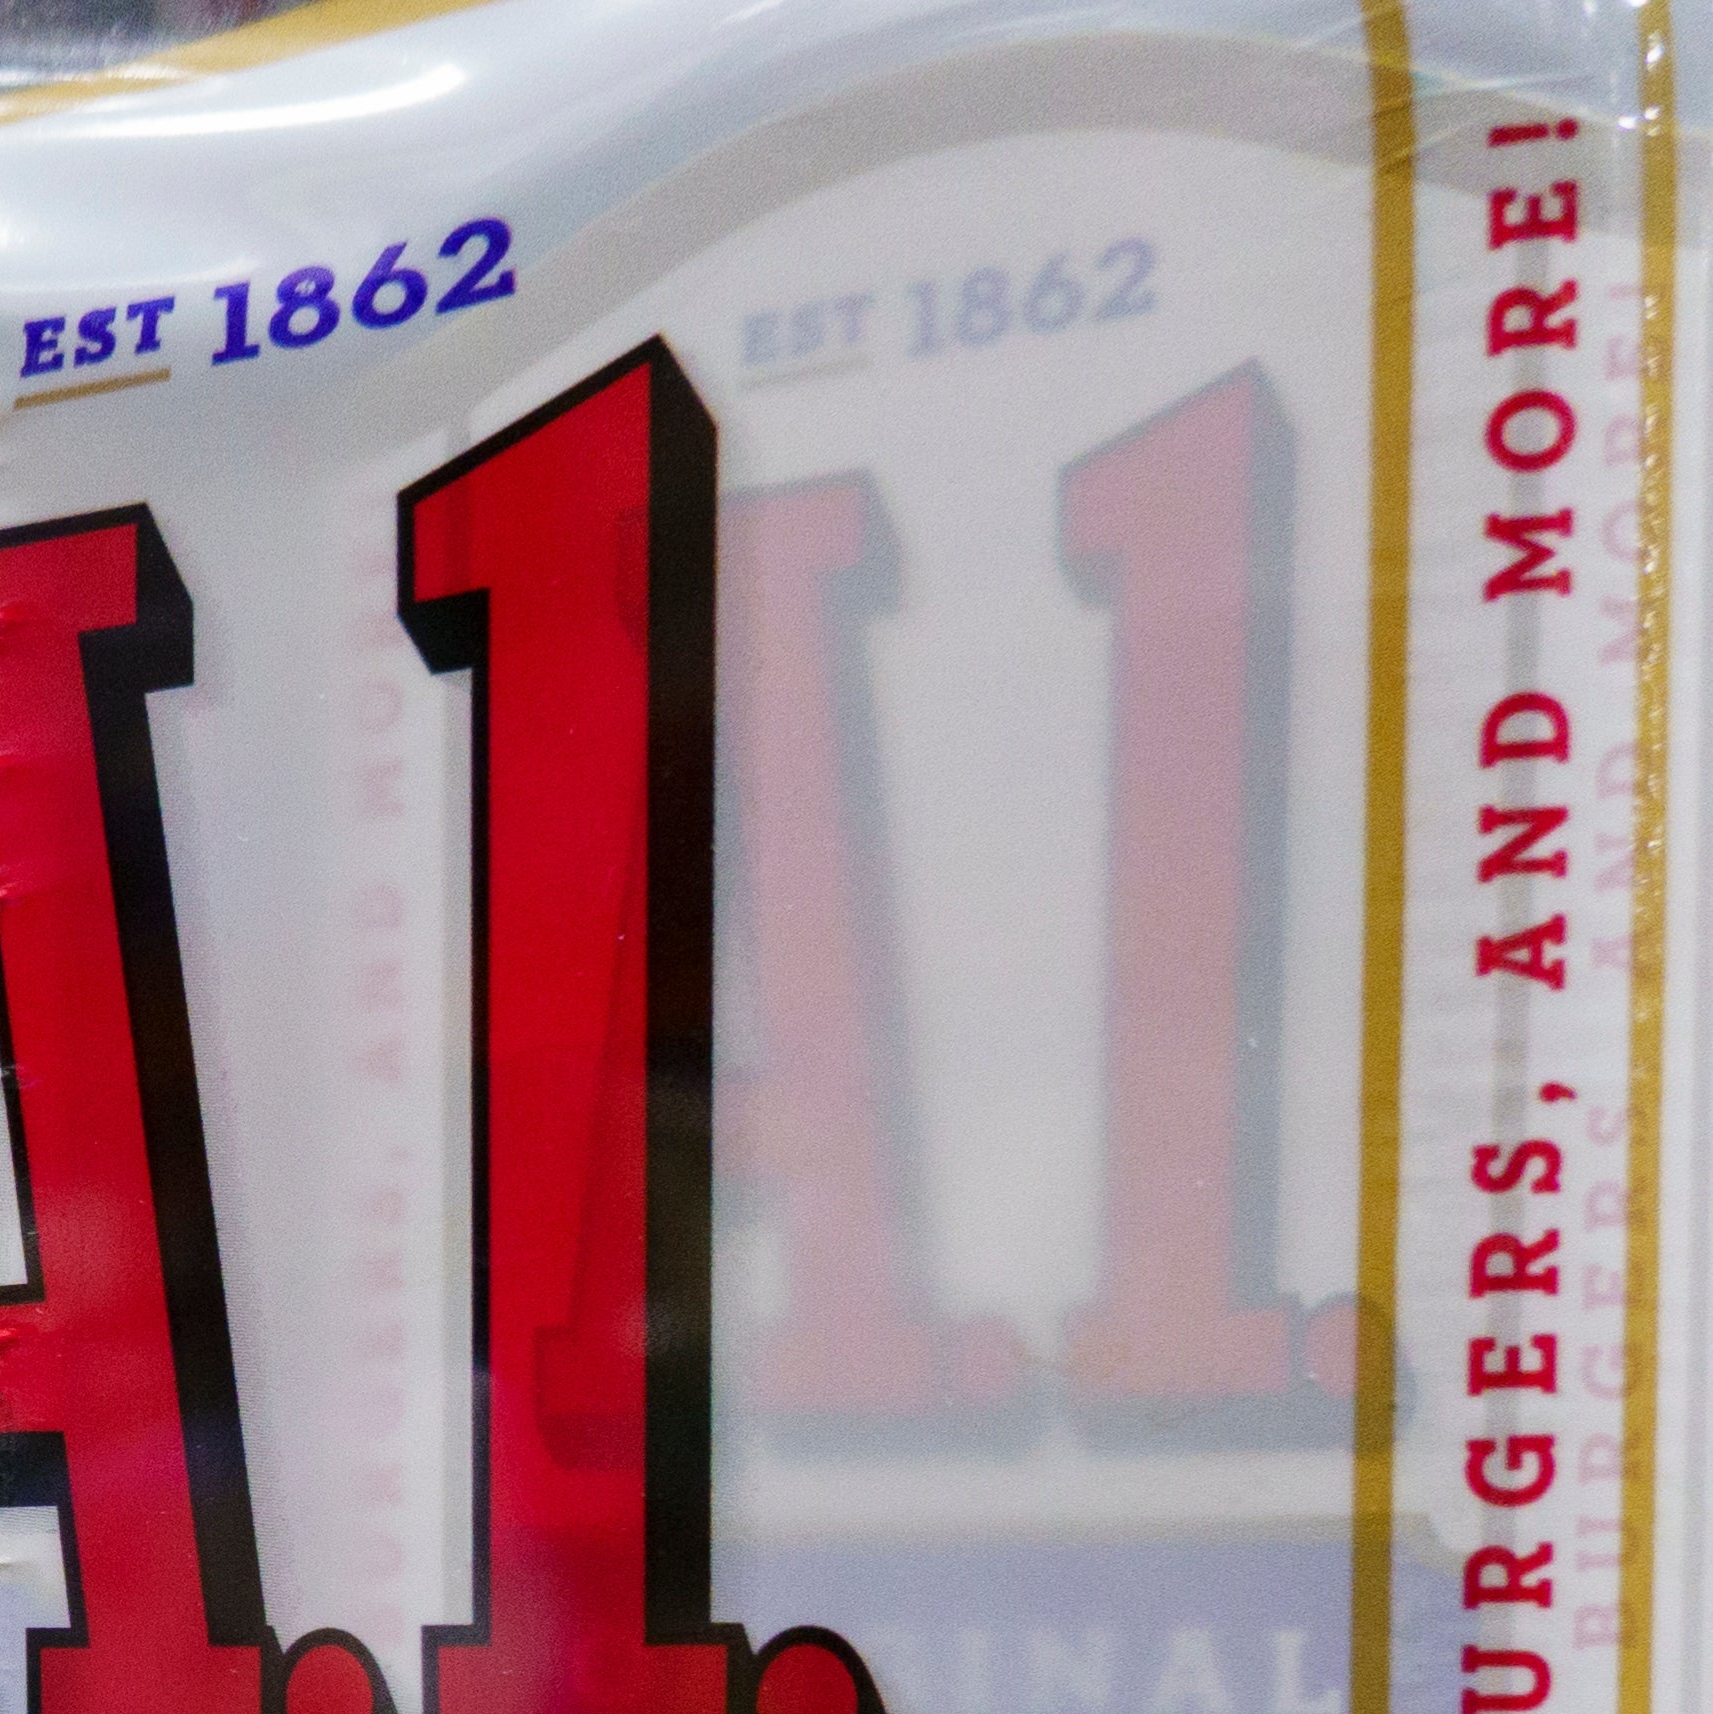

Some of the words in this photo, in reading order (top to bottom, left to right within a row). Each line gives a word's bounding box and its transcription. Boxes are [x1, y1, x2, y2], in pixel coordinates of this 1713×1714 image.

[21, 296, 176, 378] EST
[211, 215, 517, 366] 1862
[1482, 116, 1581, 604] MORE!
[1474, 690, 1573, 992] AND
